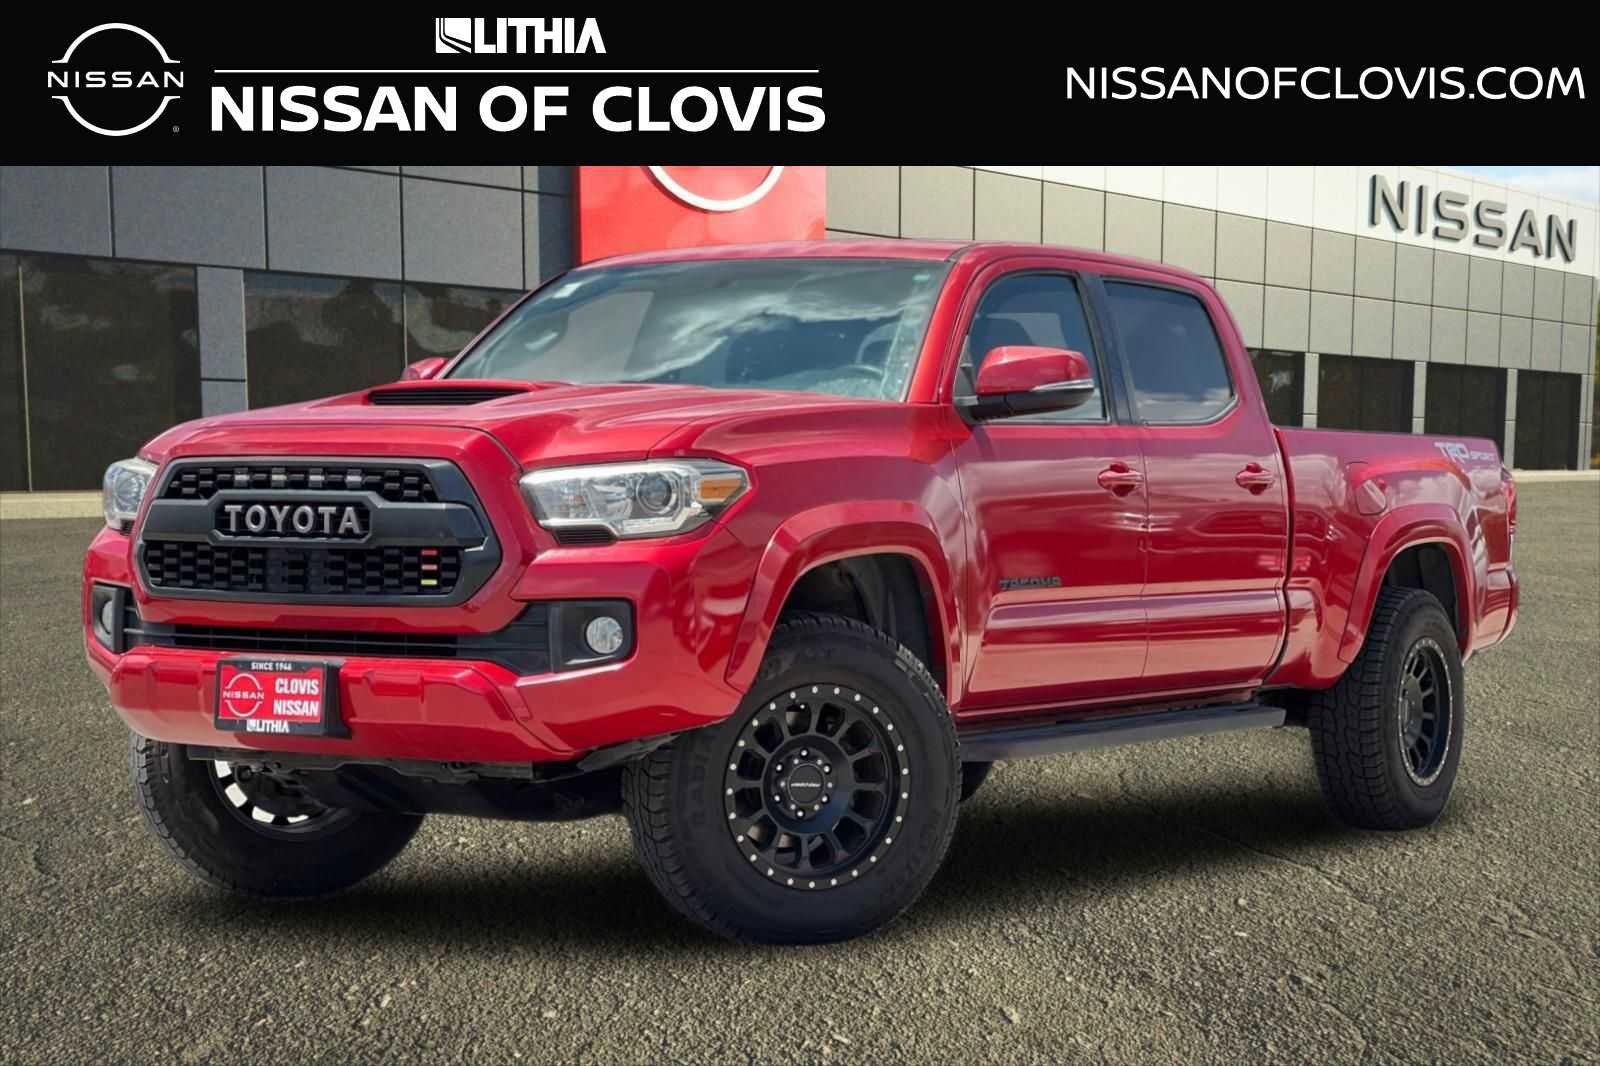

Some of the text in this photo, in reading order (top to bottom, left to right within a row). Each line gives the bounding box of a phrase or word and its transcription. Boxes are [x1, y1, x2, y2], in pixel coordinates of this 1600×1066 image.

[1369, 173, 1577, 263] NISSAN
[224, 504, 361, 534] TOYOTA
[251, 661, 273, 671] SINCE
[223, 690, 264, 700] NISSAN
[275, 677, 319, 696] CLOVIS
[273, 700, 319, 717] NISSAN
[256, 720, 290, 734] LITHIA
